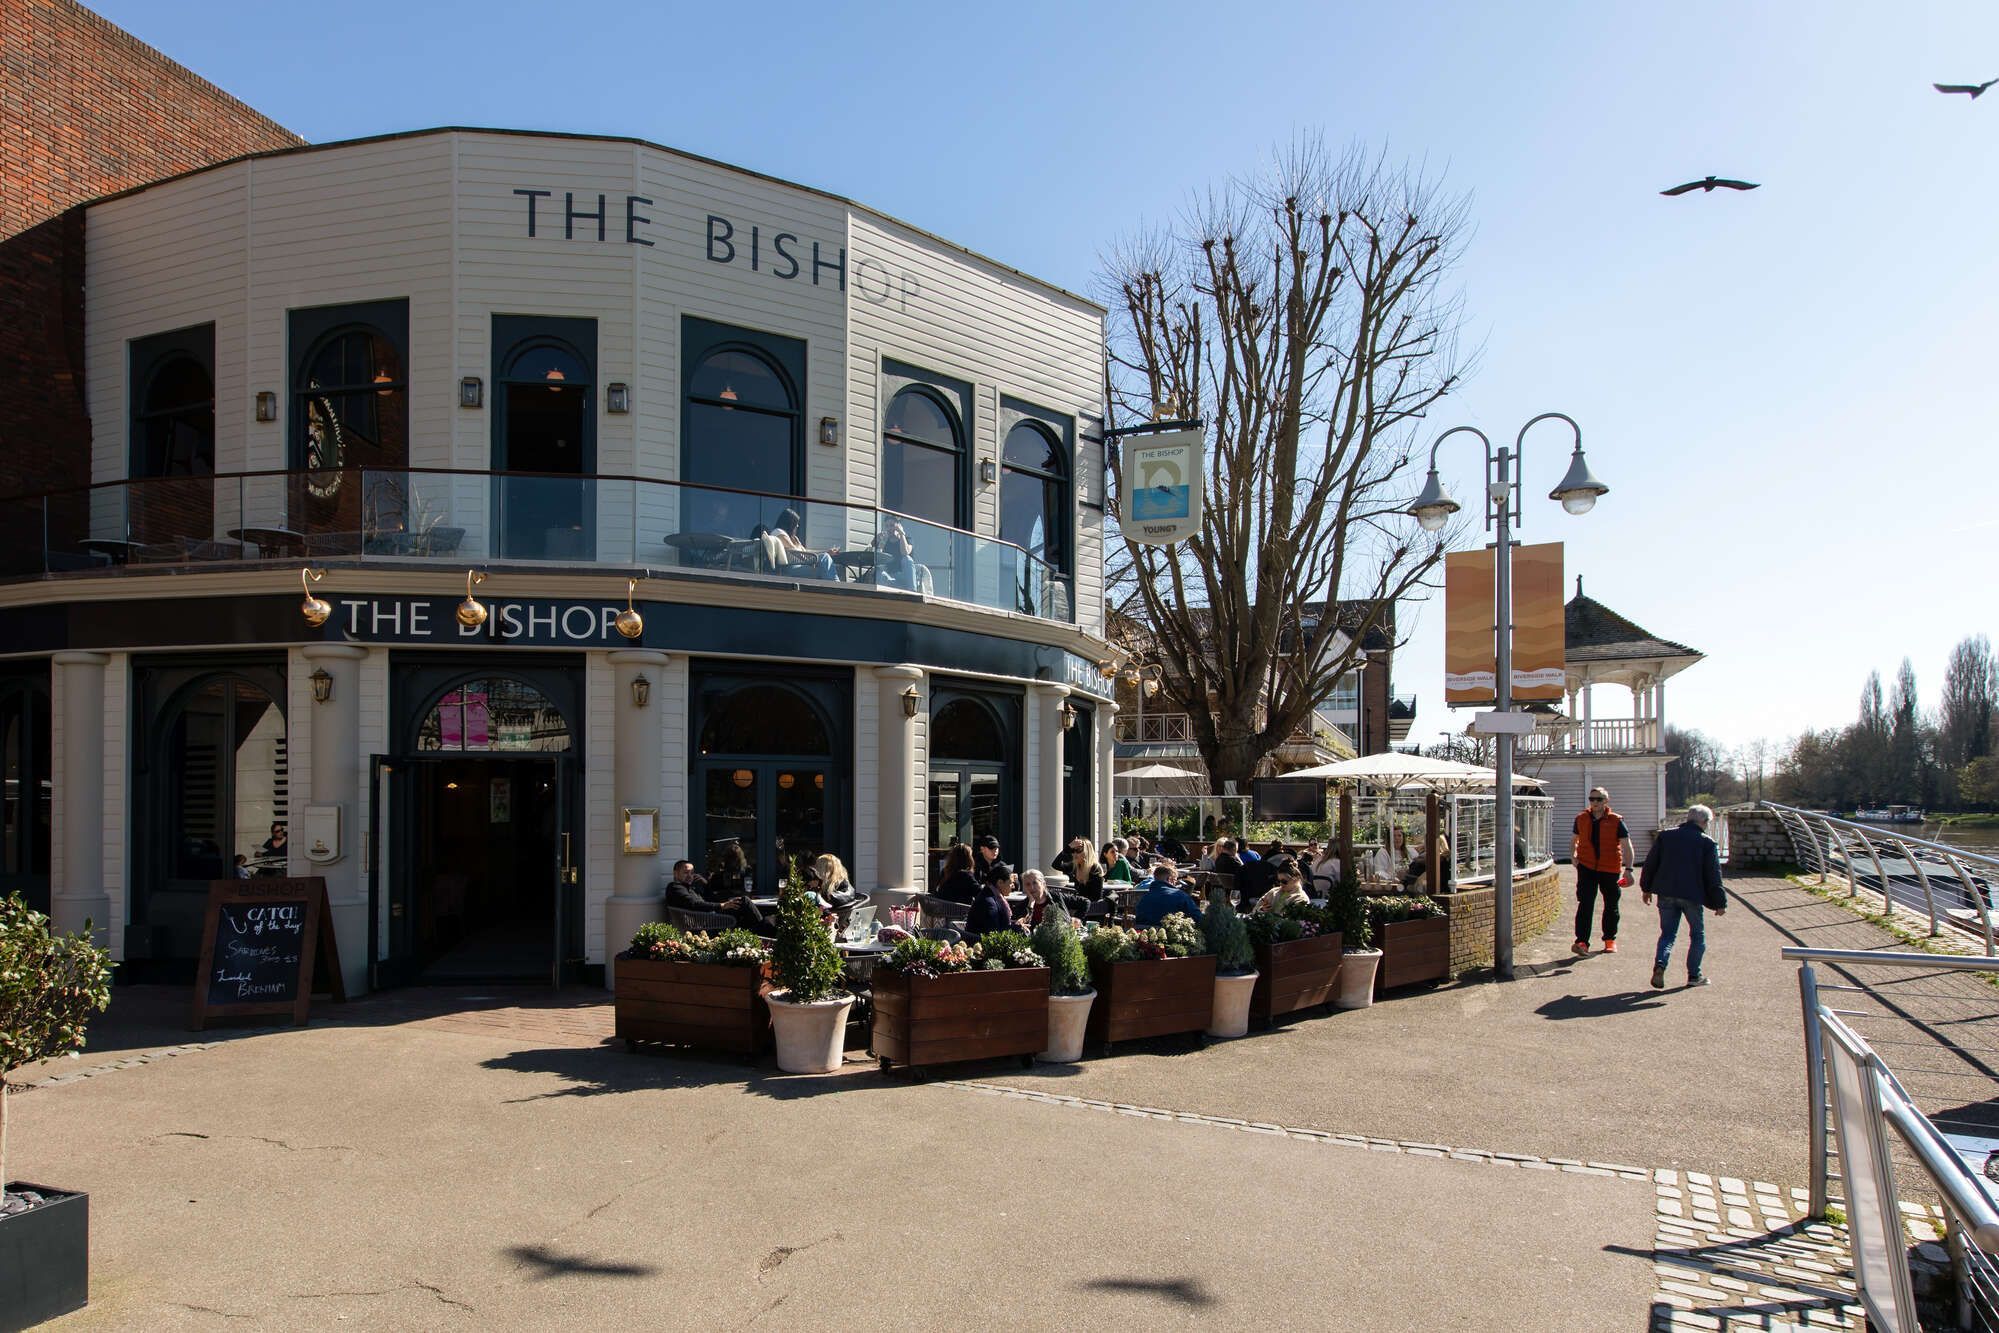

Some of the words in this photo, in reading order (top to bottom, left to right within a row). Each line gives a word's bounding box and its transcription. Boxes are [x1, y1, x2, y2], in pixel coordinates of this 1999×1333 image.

[513, 189, 655, 247] THE
[706, 214, 921, 312] BISHOP
[1157, 448, 1184, 457] BISHOP
[341, 600, 432, 635] THE
[1067, 656, 1083, 685] THE
